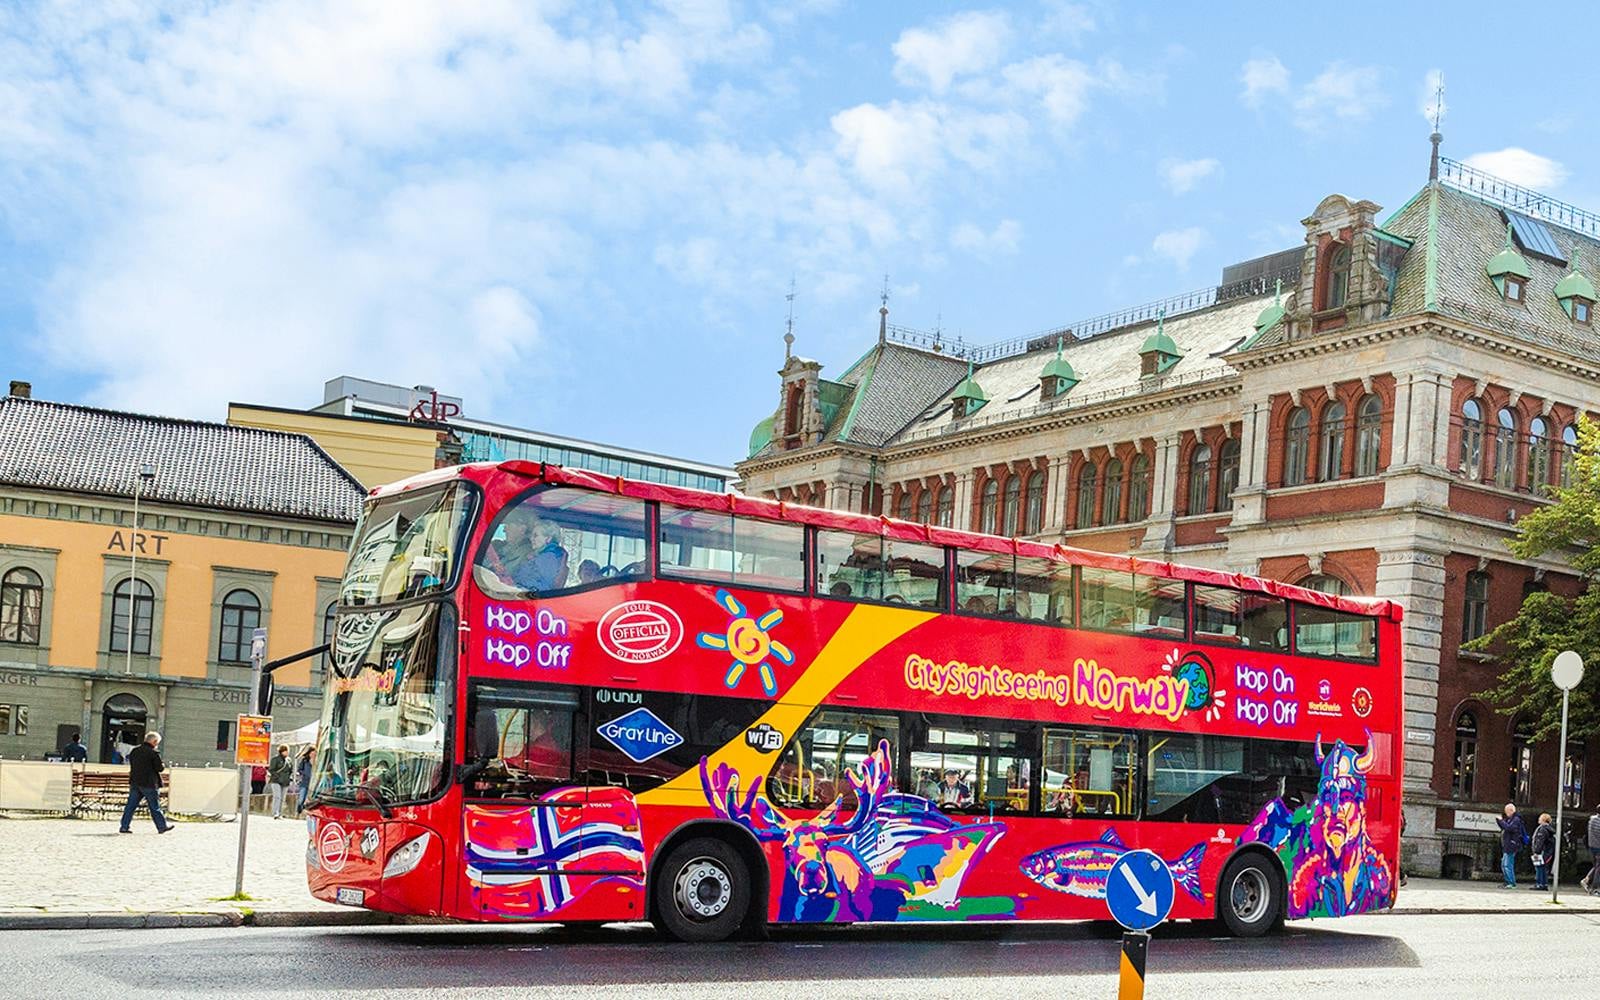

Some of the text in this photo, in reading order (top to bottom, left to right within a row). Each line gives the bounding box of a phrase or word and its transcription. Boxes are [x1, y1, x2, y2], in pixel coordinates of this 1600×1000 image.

[107, 531, 169, 555] ART
[486, 605, 566, 635] Hop On
[624, 603, 653, 614] TOUR
[613, 623, 668, 640] OFFICIAL
[486, 638, 571, 667] Hop Off
[616, 644, 669, 660] OF NORWAY
[1073, 657, 1190, 722] Norway
[1236, 665, 1294, 693] Hop On
[212, 690, 304, 708] EXHIONS
[1236, 697, 1298, 725] Hop Off
